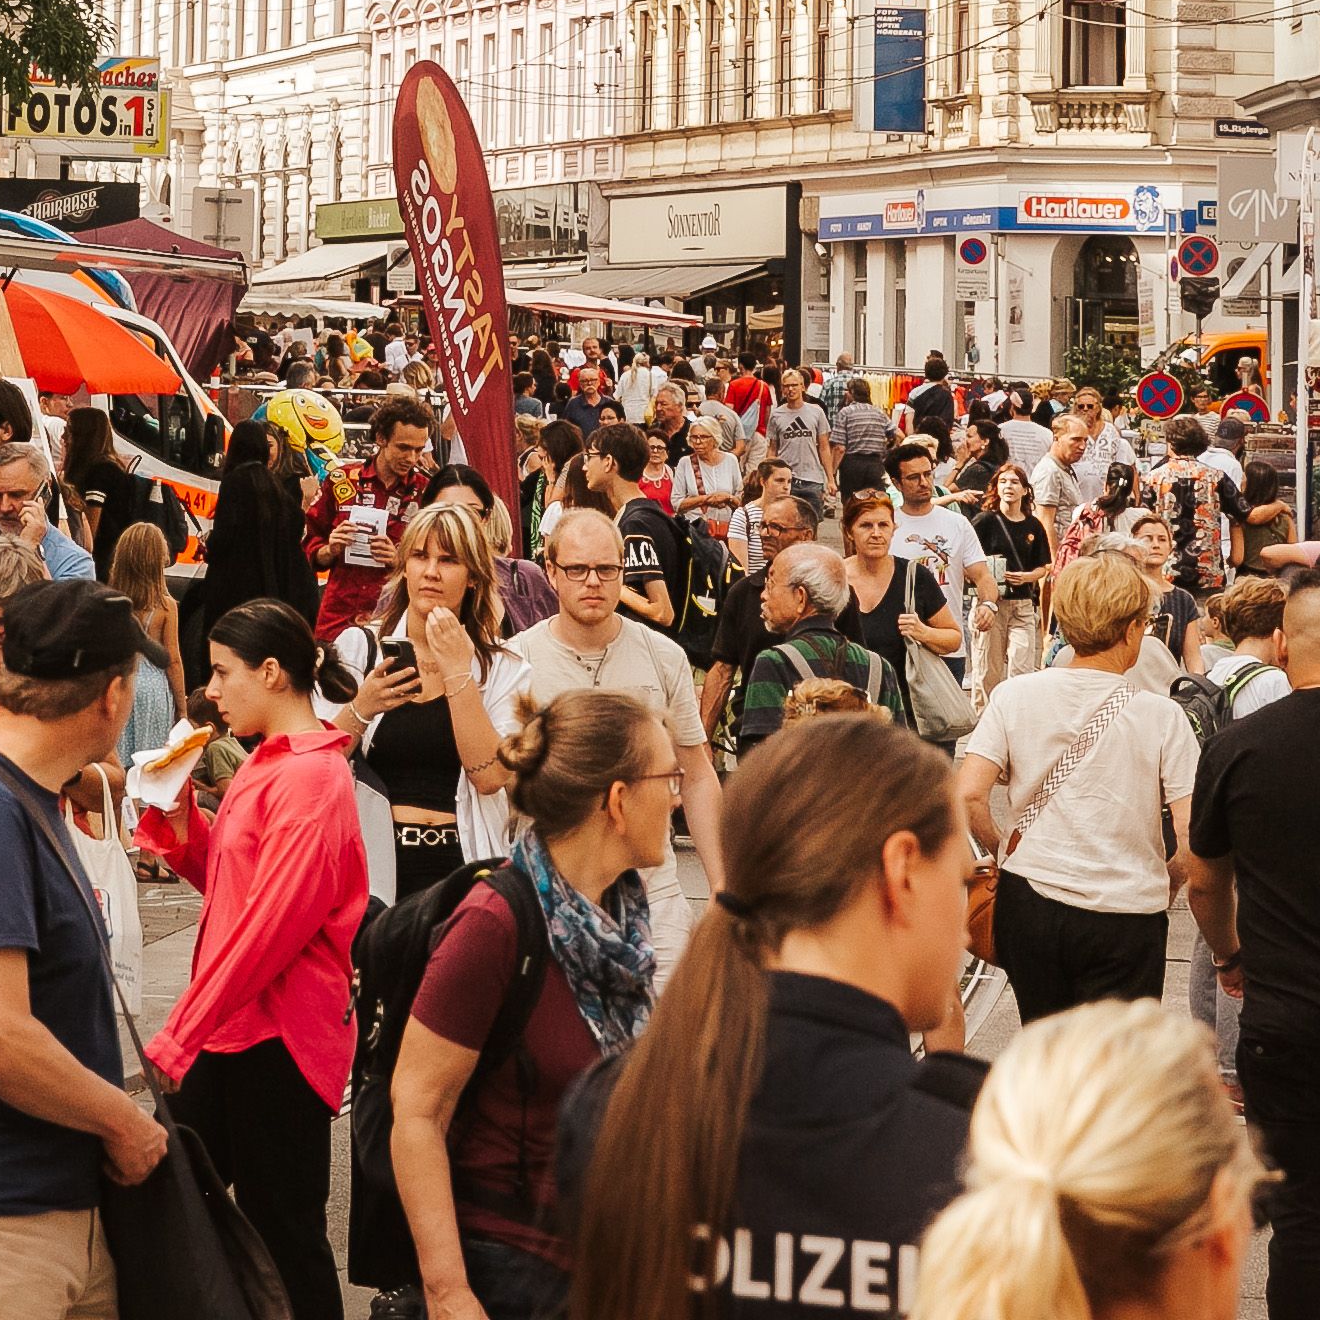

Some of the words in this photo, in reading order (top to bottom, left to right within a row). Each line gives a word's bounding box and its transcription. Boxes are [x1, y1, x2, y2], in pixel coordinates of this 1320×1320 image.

[101, 66, 157, 88] acher
[124, 96, 145, 137] 1
[119, 120, 132, 136] in
[31, 190, 97, 221] HAIRBASE
[1031, 197, 1123, 219] Hartlauer
